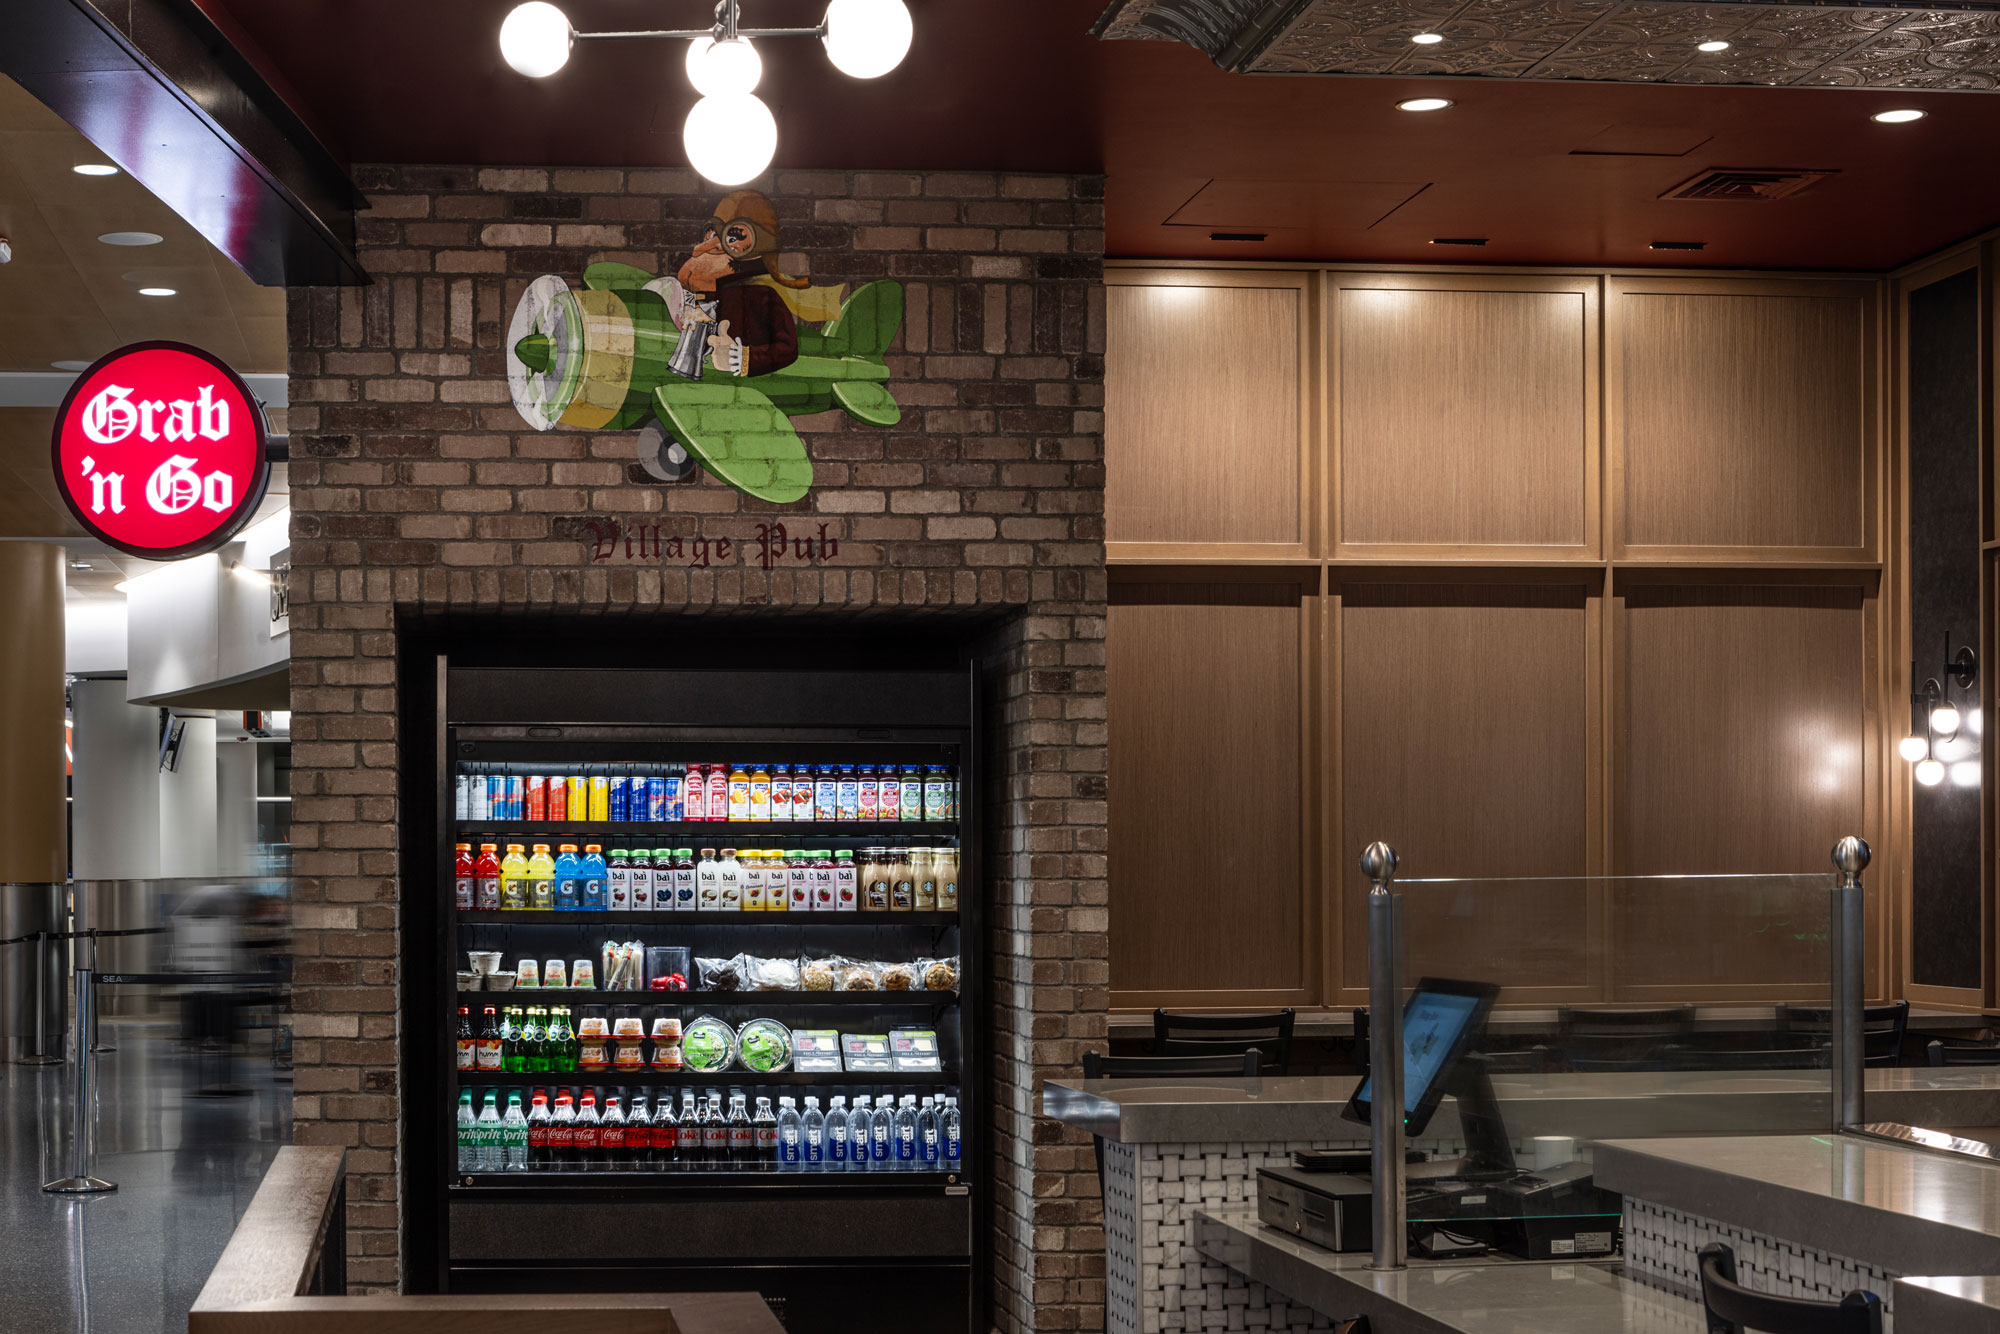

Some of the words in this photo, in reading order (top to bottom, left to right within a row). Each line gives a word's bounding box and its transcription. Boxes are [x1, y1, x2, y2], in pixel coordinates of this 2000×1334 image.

[82, 384, 230, 444] Grab
[146, 454, 233, 515] Go
[583, 522, 732, 569] Village
[754, 522, 839, 571] Pub
[613, 871, 625, 880] bai
[634, 871, 647, 880] bai
[656, 872, 670, 881] bai
[678, 871, 691, 881] bai
[702, 872, 715, 880] bai
[723, 872, 736, 881] bai
[791, 870, 804, 880] bai
[817, 871, 830, 880] bai
[839, 870, 852, 880] bai
[485, 880, 497, 895] G
[505, 880, 518, 895] G
[536, 881, 549, 895] G
[561, 880, 573, 894] G
[586, 880, 599, 894] G
[102, 975, 123, 983] SEA
[759, 1129, 778, 1140] Cok
[874, 1126, 883, 1157] smart
[901, 1126, 910, 1157] smart
[947, 1126, 957, 1157] smart
[784, 1129, 794, 1161] smart
[809, 1129, 818, 1161] smart
[835, 1126, 844, 1158] smart
[855, 1129, 864, 1160] smart
[925, 1129, 934, 1160] smart
